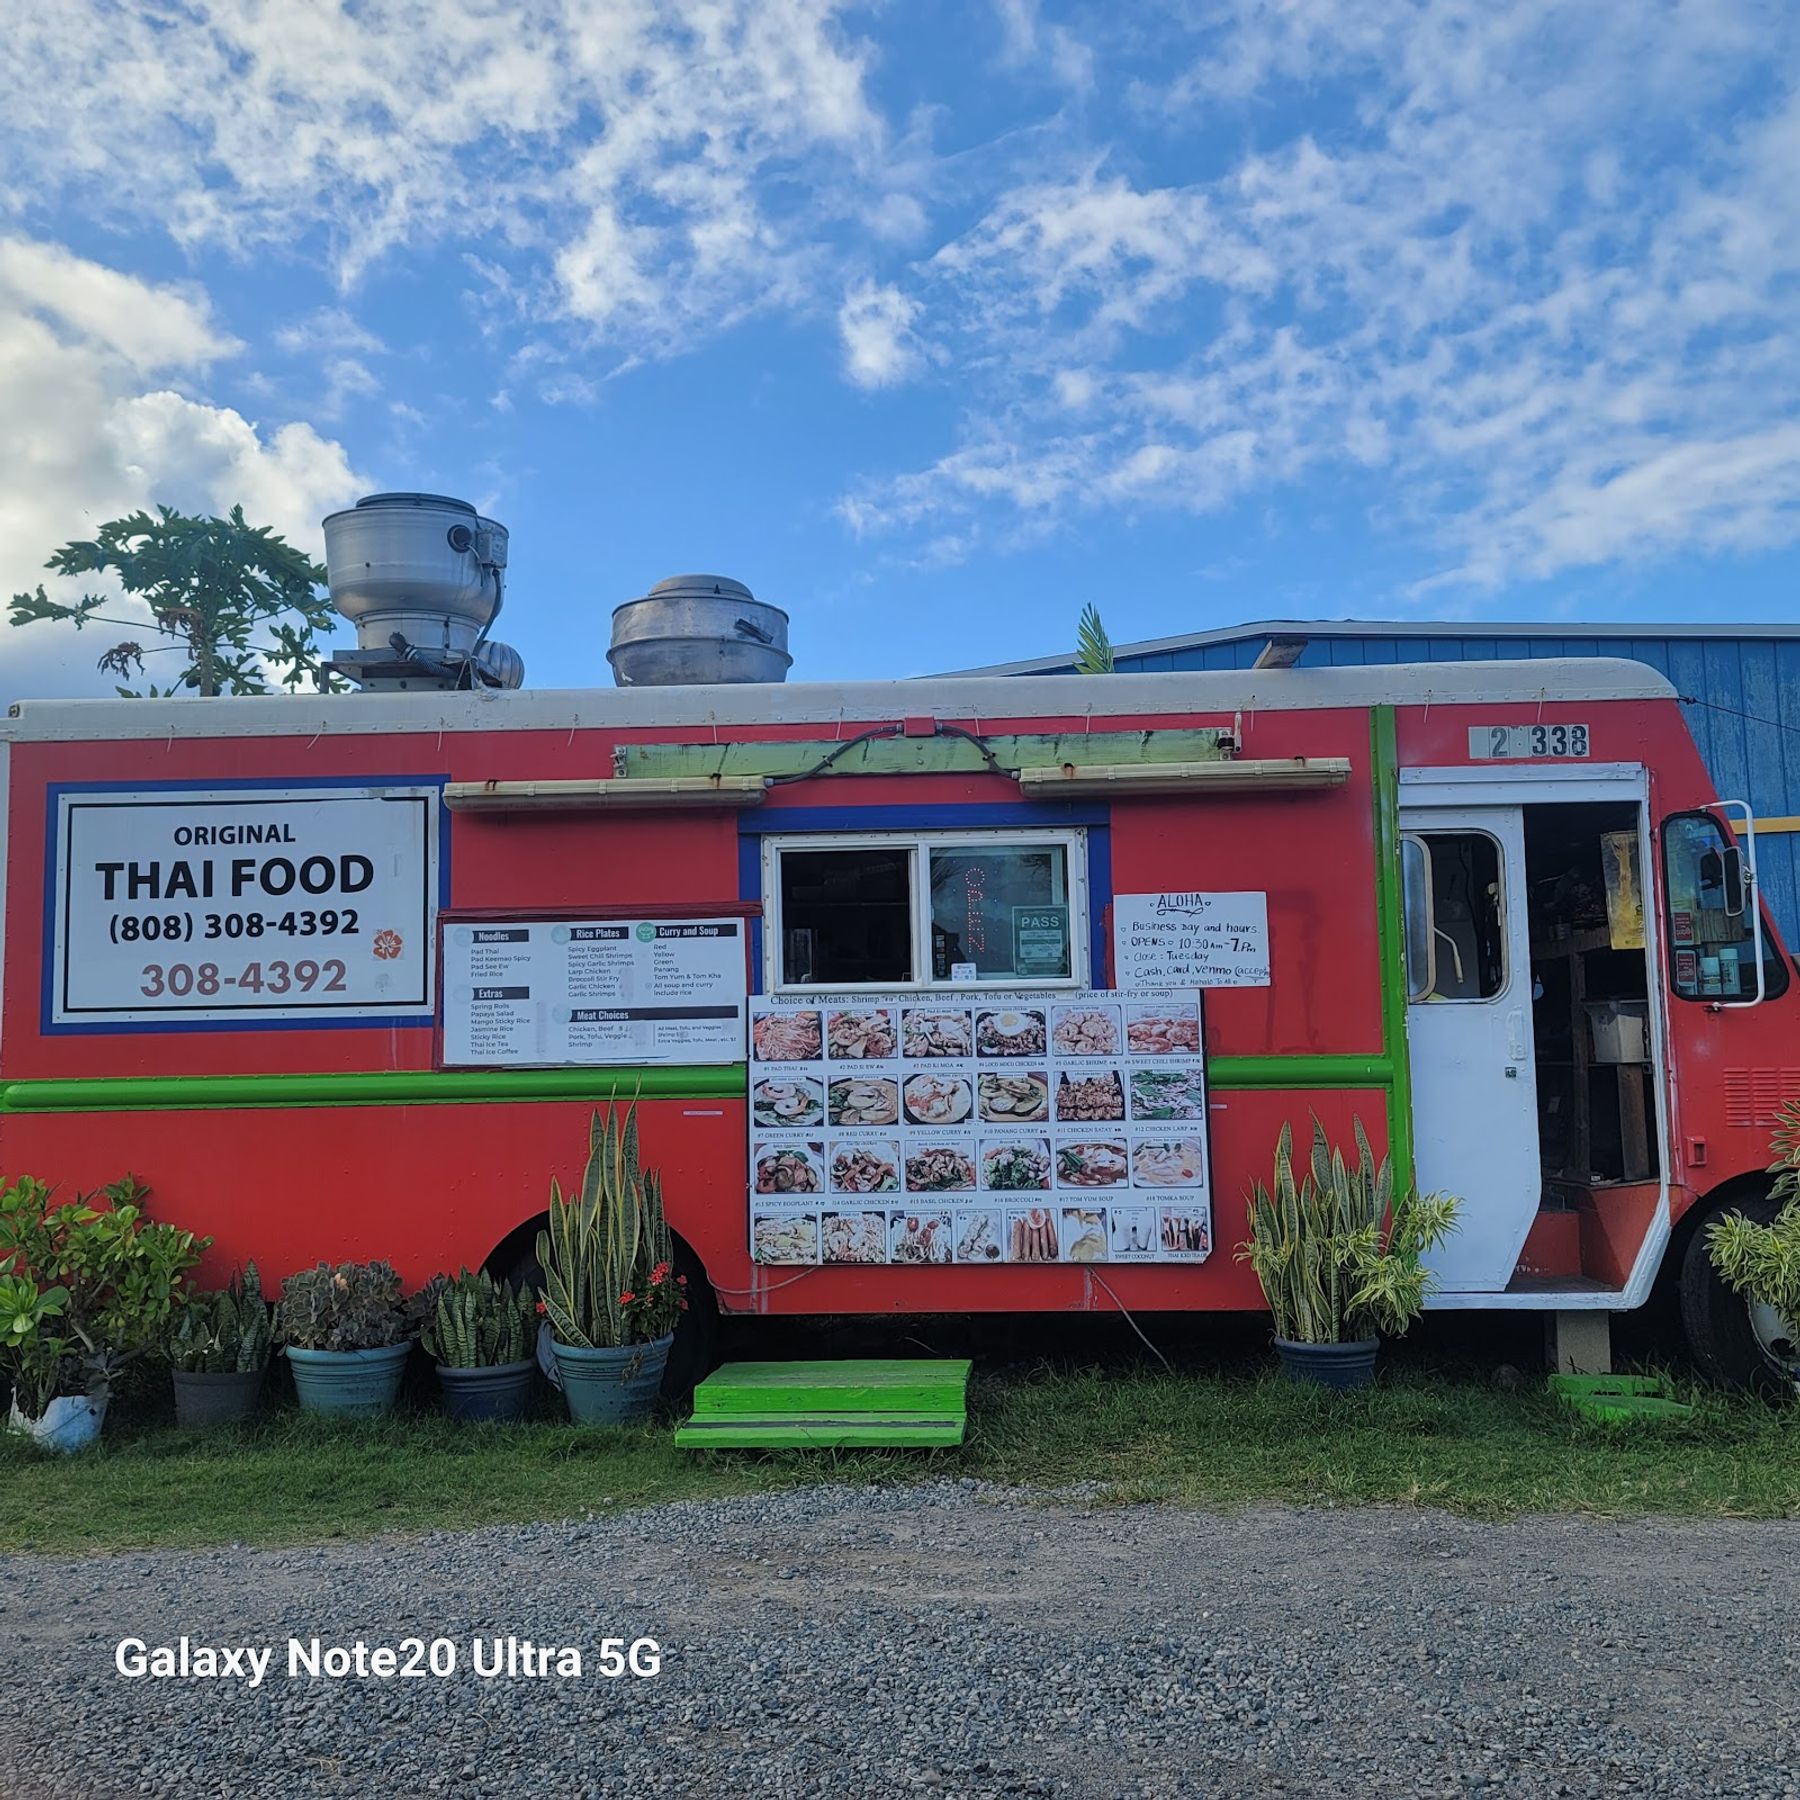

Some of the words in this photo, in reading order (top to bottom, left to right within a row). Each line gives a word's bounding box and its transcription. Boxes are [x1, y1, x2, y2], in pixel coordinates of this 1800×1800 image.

[174, 823, 296, 846] ORIGINAL
[95, 860, 213, 900] THAI
[232, 854, 374, 896] FOOD
[1157, 894, 1203, 908] ALOHA
[965, 867, 985, 953] OPEN
[109, 913, 193, 944] (808)
[204, 909, 359, 939] 308-4392
[1021, 916, 1059, 928] PASS
[1132, 922, 1176, 932] Business
[1204, 922, 1221, 932] and
[478, 932, 509, 941] Noodles
[576, 929, 594, 939] Rice
[595, 928, 620, 938] Plates
[659, 927, 681, 937] Curry
[683, 926, 697, 935] and
[699, 926, 719, 936] Soup
[1131, 937, 1166, 947] OPENS
[1167, 951, 1209, 962] Tuesday
[140, 959, 347, 998] 308-4392
[479, 989, 503, 999] Extras
[770, 995, 801, 1005] Choice
[806, 995, 816, 1005] of
[818, 994, 849, 1004] Meats:
[851, 995, 880, 1005] Shrimp
[898, 993, 933, 1003] Chicken,
[960, 992, 981, 1002] Pork,
[983, 992, 1001, 1000] Tofu
[1015, 992, 1056, 1001] Vegetables
[1075, 991, 1098, 1001] (price
[1100, 990, 1109, 998] of
[1111, 990, 1138, 1000] stir-fry
[1151, 990, 1174, 1000] soup)
[577, 1011, 596, 1020] Meat
[598, 1010, 629, 1020] Choices
